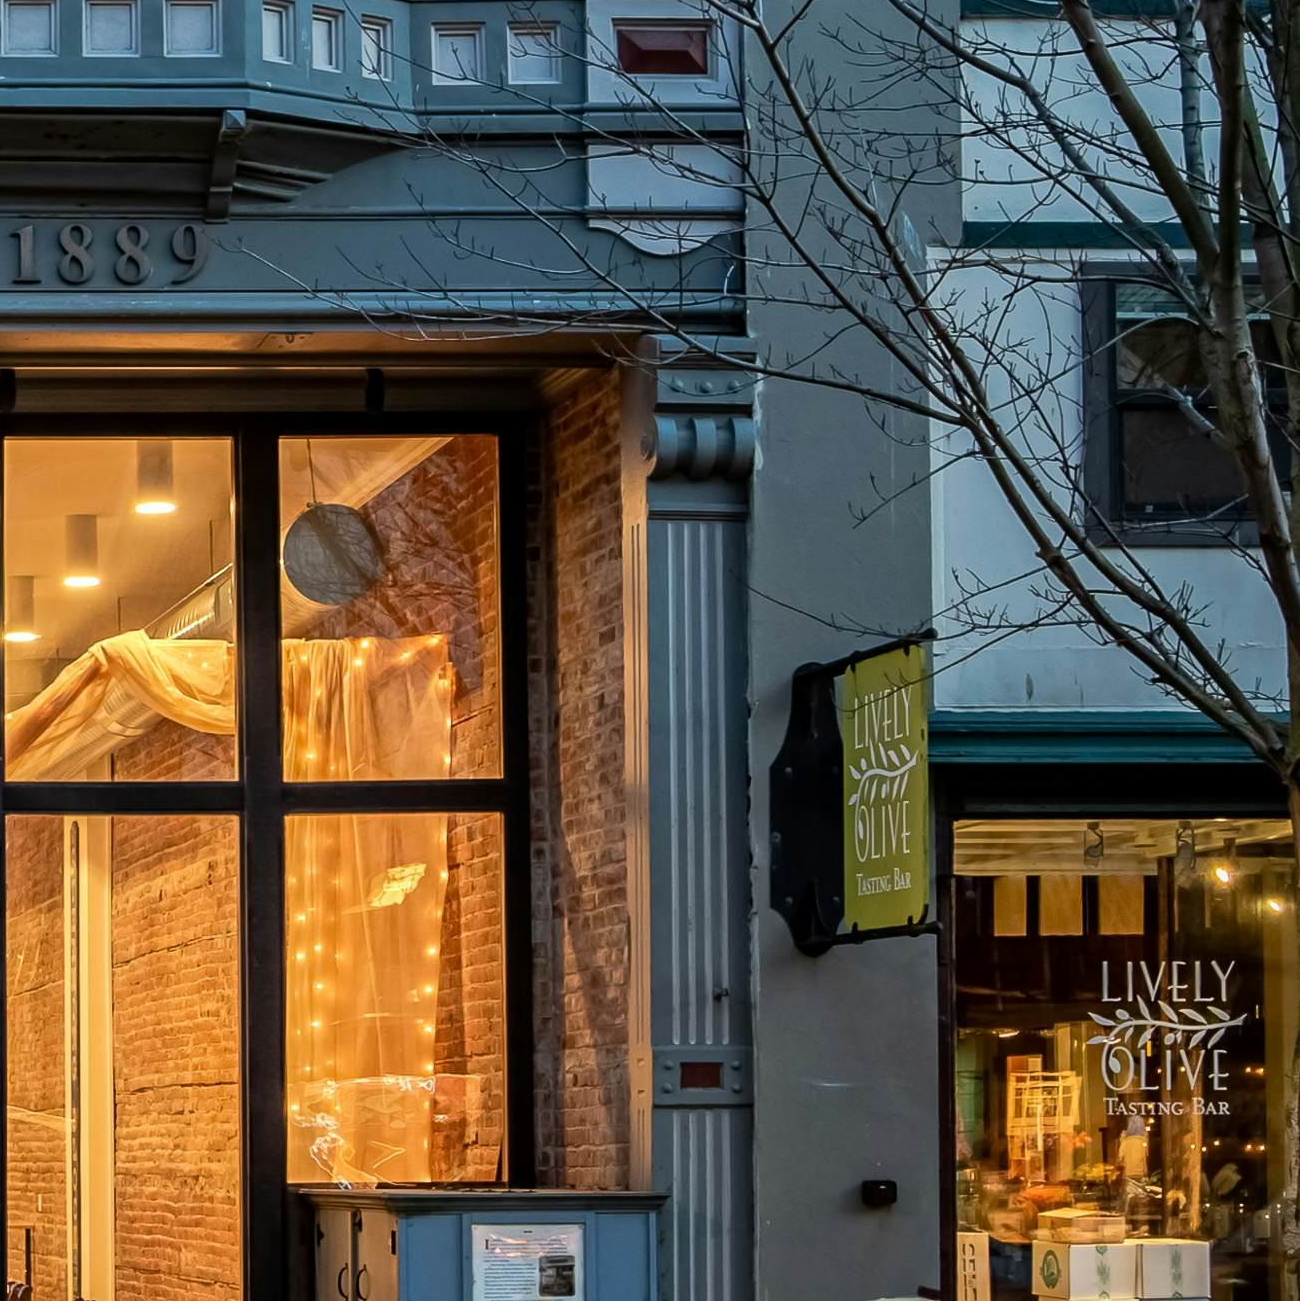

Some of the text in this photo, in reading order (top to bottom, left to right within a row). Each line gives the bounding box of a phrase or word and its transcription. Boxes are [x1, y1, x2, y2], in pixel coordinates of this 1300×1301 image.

[9, 223, 208, 286] 1889
[854, 684, 913, 750] LIVELY
[854, 799, 912, 863] OLIVE
[893, 867, 912, 892] BAR
[1101, 960, 1236, 1002] LIVELY
[1101, 1045, 1230, 1092] OLIVE
[1102, 1096, 1231, 1116] TASTING BAR
